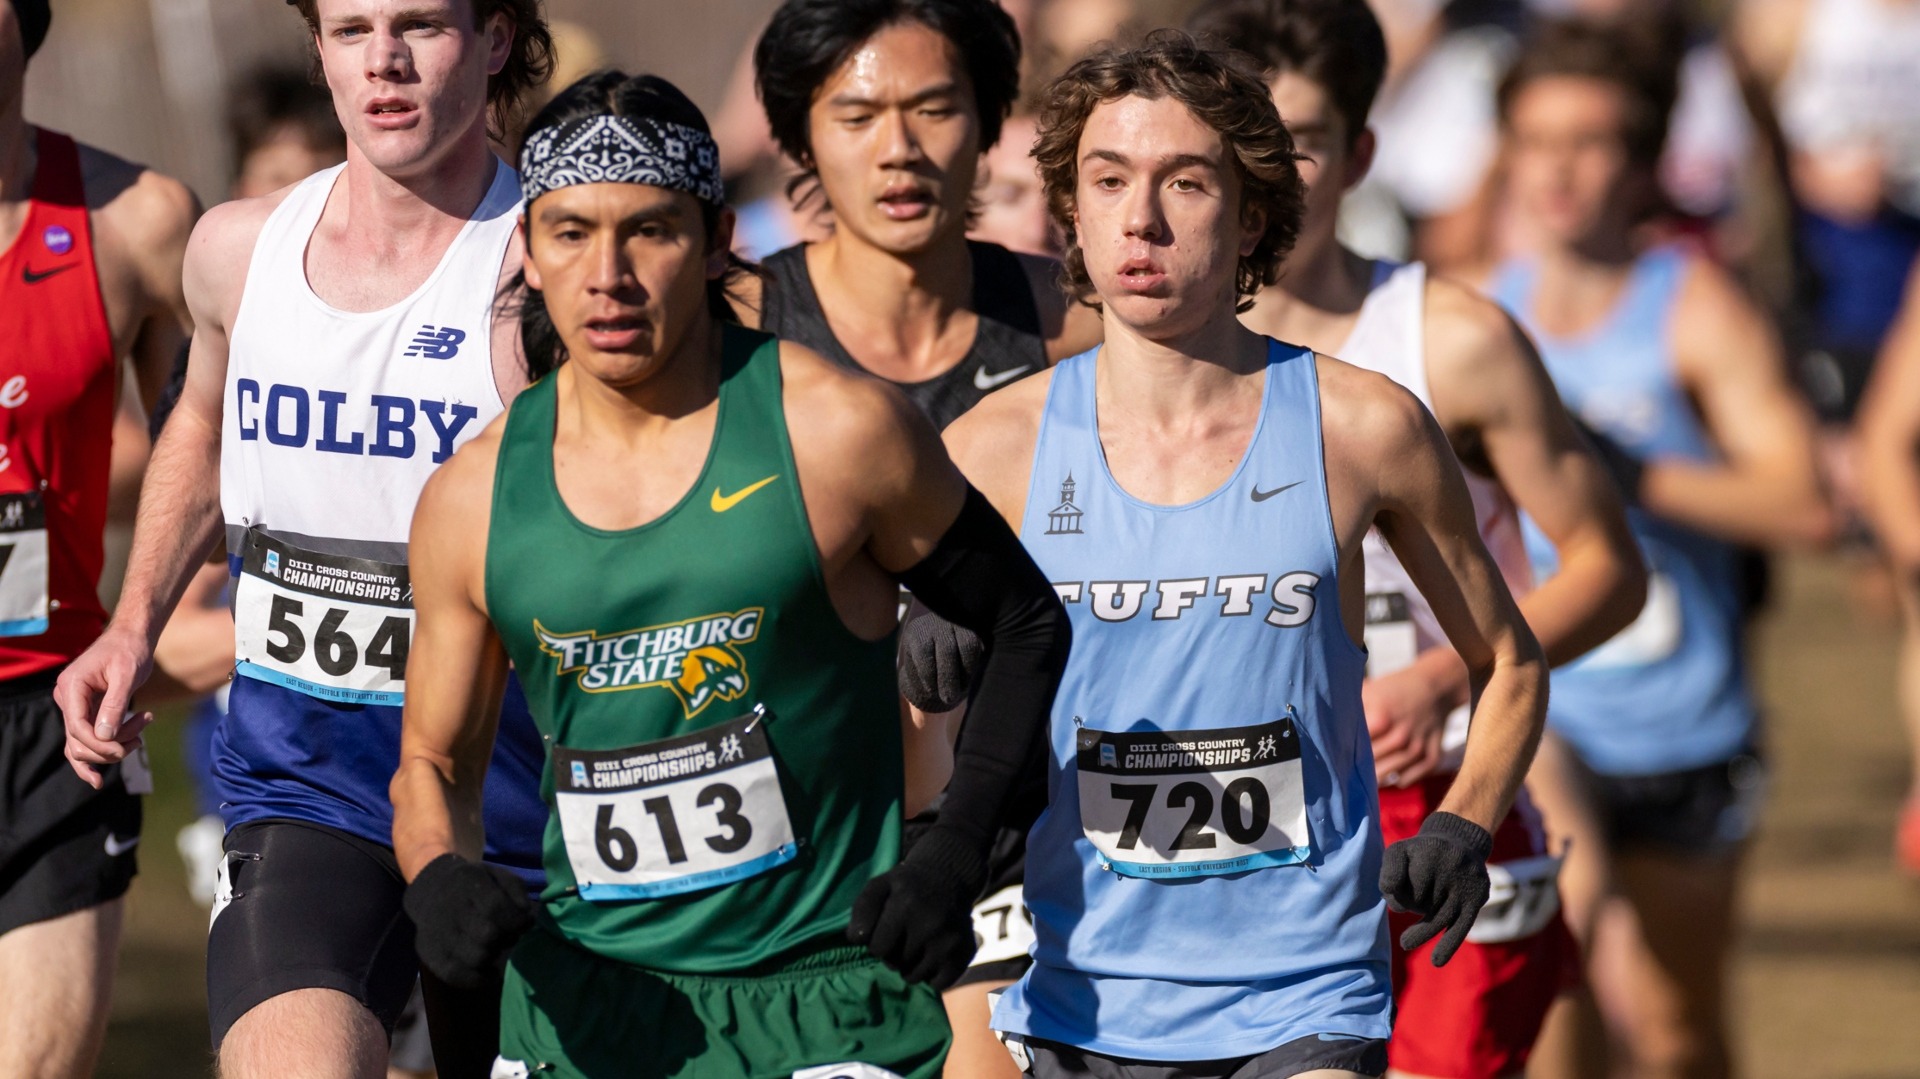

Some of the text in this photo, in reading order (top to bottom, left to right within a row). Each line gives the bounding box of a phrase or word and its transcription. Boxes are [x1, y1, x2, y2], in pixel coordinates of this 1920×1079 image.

[237, 377, 478, 465] COLBY
[283, 567, 401, 601] CHAMPIONSHIPS
[288, 559, 314, 572] DIII
[316, 565, 349, 579] CROSS
[350, 571, 397, 586] COUNTRY
[266, 593, 411, 681] 564
[540, 612, 759, 670] FITCHBURG
[581, 651, 688, 689] STATE
[622, 753, 659, 769] CROSS
[658, 742, 708, 761] COUNTRY
[1124, 748, 1252, 769] CHAMPIONSHIPS
[1129, 738, 1246, 753] DIII CROSS COUNTRY
[592, 751, 717, 789] CHAMPIONSHIPS
[594, 782, 753, 873] 613
[1110, 776, 1271, 851] 720
